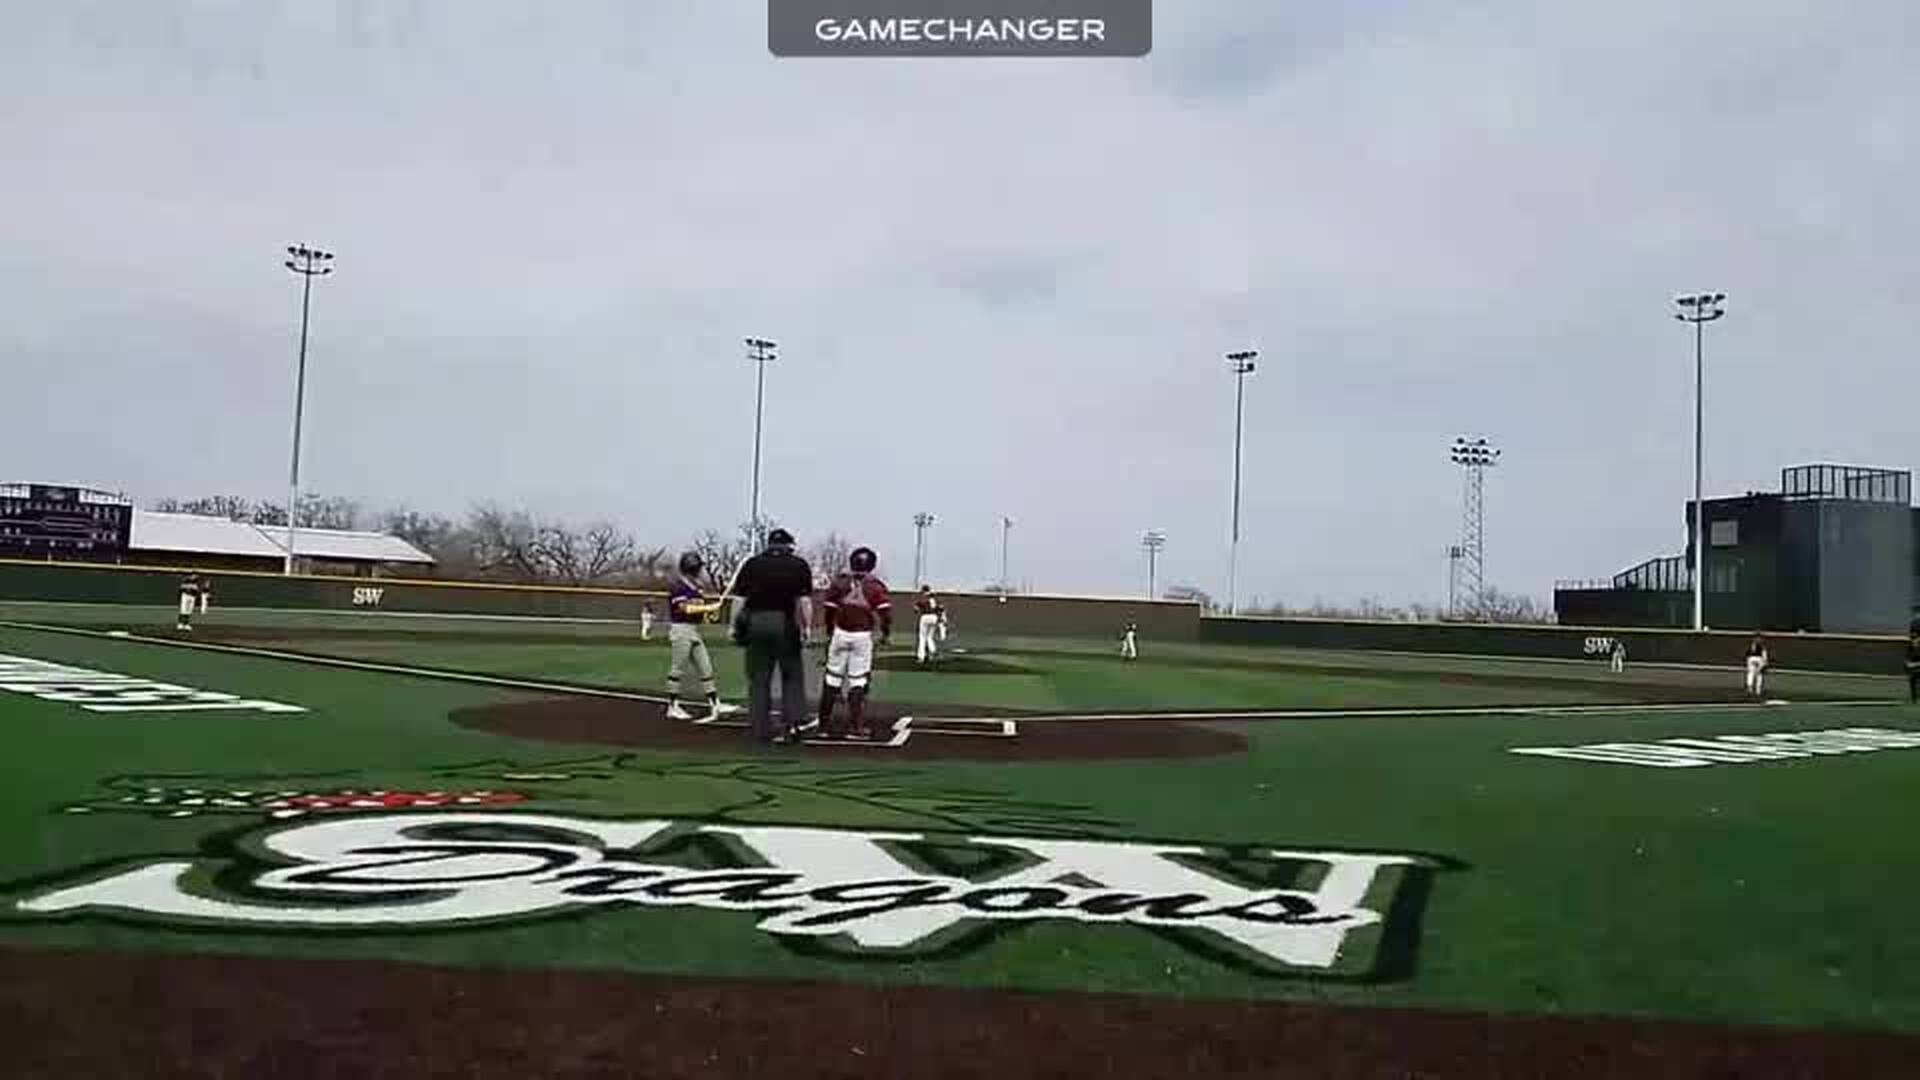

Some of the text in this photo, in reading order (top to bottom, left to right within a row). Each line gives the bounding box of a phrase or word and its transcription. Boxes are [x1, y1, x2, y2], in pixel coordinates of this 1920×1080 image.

[352, 587, 384, 605] SW
[1583, 637, 1615, 654] SW
[282, 843, 1358, 928] Dragons
